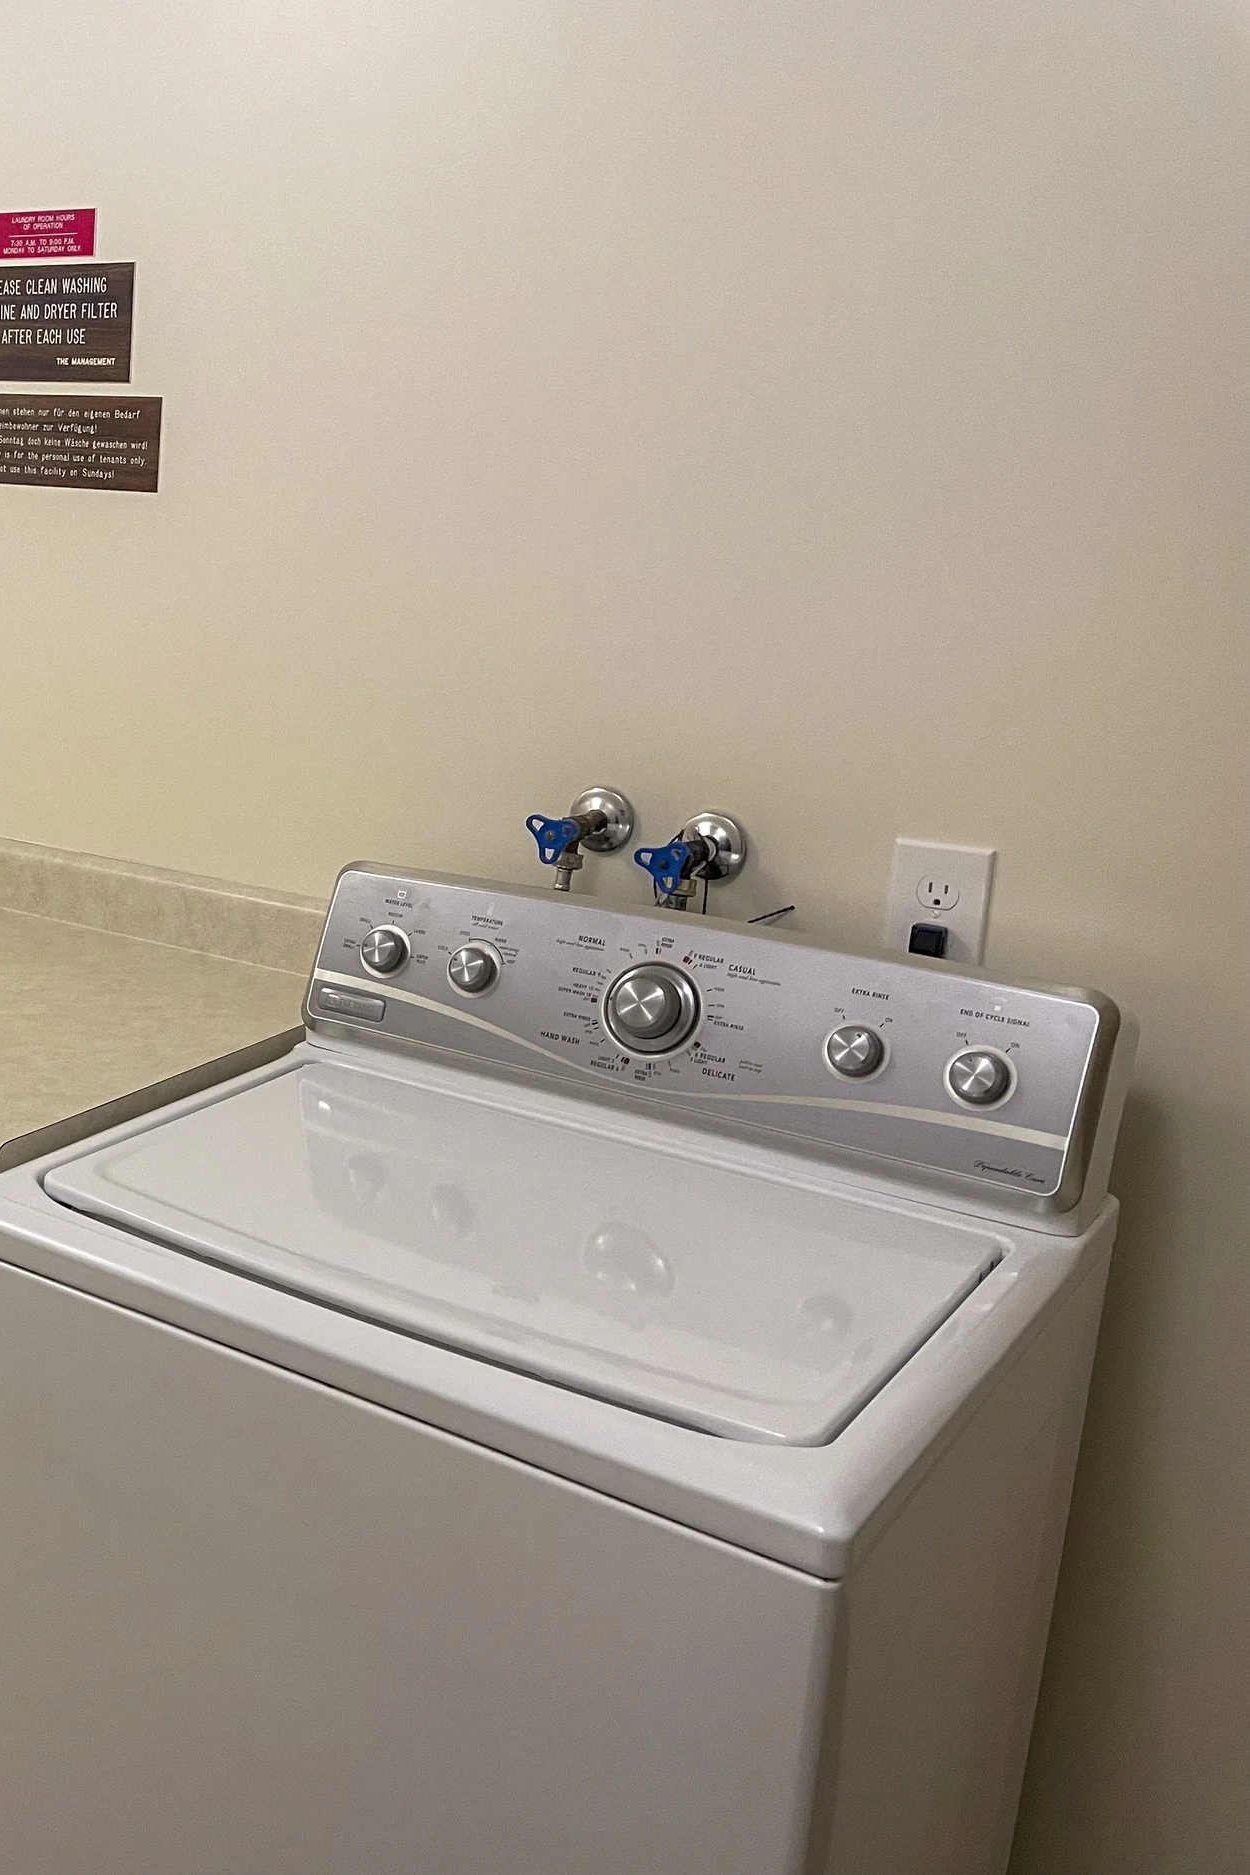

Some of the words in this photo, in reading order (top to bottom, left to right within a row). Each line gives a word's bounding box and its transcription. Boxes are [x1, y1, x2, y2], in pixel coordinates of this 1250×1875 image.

[12, 215, 35, 224] LAUNDRY
[33, 222, 63, 230] OPERATION
[11, 239, 23, 247] 7:30
[3, 247, 25, 255] MONDAY
[37, 245, 65, 253] SATURDAY
[26, 278, 58, 295] CLEAN
[62, 277, 107, 294] WASHING
[20, 304, 40, 320] AND
[44, 303, 77, 319] DRYER
[81, 302, 118, 319] FILTER
[1, 328, 32, 344] AFTER
[36, 328, 62, 344] EACH
[66, 328, 86, 344] USE
[56, 357, 69, 366] THE
[71, 357, 116, 366] MANAGEMENT
[13, 407, 35, 416] stehen
[38, 409, 50, 417] nur
[53, 408, 64, 417] für
[68, 409, 80, 418] den
[84, 410, 110, 420] eigenen
[114, 409, 141, 419] Bedarf
[43, 424, 54, 432] zur
[58, 423, 98, 435] Verfügung!
[28, 437, 41, 445] doch
[44, 438, 61, 447] keine
[64, 438, 90, 448] Wäsche
[92, 440, 128, 450] gewaschen
[131, 441, 148, 450] wird!
[5, 451, 10, 459] is
[13, 450, 25, 459] for
[28, 452, 39, 460] the
[41, 453, 70, 462] personal
[73, 454, 85, 462] use
[88, 454, 96, 462] of
[99, 454, 127, 464] tenants
[10, 466, 21, 474] use
[24, 466, 37, 475] this
[40, 466, 67, 477] facility
[70, 469, 78, 477] on
[82, 468, 115, 480] Sundays!
[400, 900, 414, 909] LEVEL
[471, 915, 504, 926] TEMPERATURE
[578, 935, 606, 946] NORMAL
[698, 954, 725, 964] REGULAR
[572, 966, 596, 977] REGULAR
[728, 964, 756, 976] CASUAL
[851, 988, 870, 997] EXTRA
[872, 991, 890, 1001] RINSE
[959, 1008, 974, 1017] END
[985, 1014, 1005, 1023] CYCLE
[1006, 1017, 1030, 1028] SIGNAL
[540, 1031, 560, 1041] HAND
[561, 1035, 581, 1046] WASH
[1011, 1041, 1020, 1049] ON
[699, 1052, 726, 1064] REGULAR
[590, 1059, 615, 1071] REGULAR
[702, 1067, 736, 1082] DELICATE
